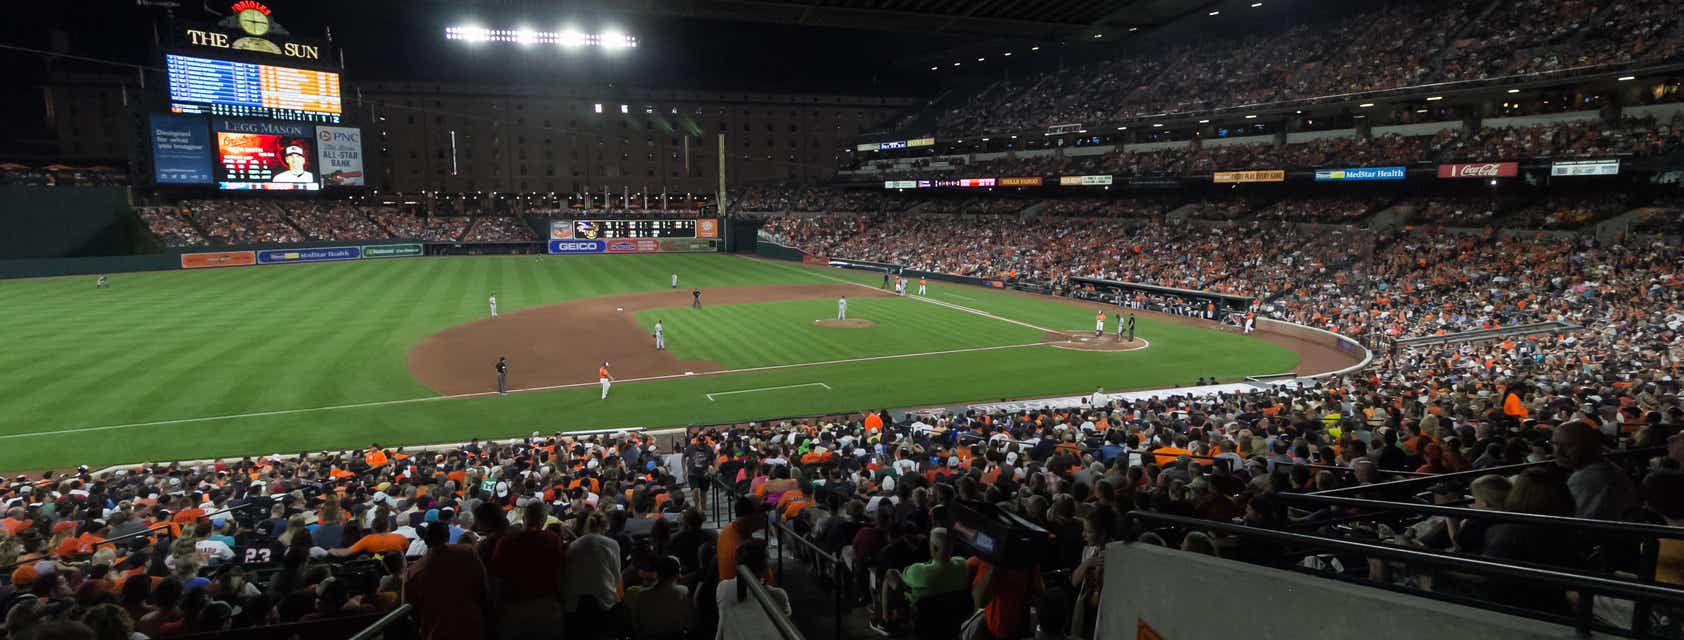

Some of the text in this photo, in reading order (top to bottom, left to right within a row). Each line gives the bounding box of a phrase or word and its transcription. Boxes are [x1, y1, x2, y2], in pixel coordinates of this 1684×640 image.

[231, 0, 272, 16] ORIOLES
[187, 30, 319, 60] THE SUN
[224, 121, 302, 135] LEGG MASON
[333, 132, 359, 143] PNC
[1346, 169, 1404, 178] MedStar Health
[559, 242, 597, 251] GEICO
[245, 548, 271, 563] 23
